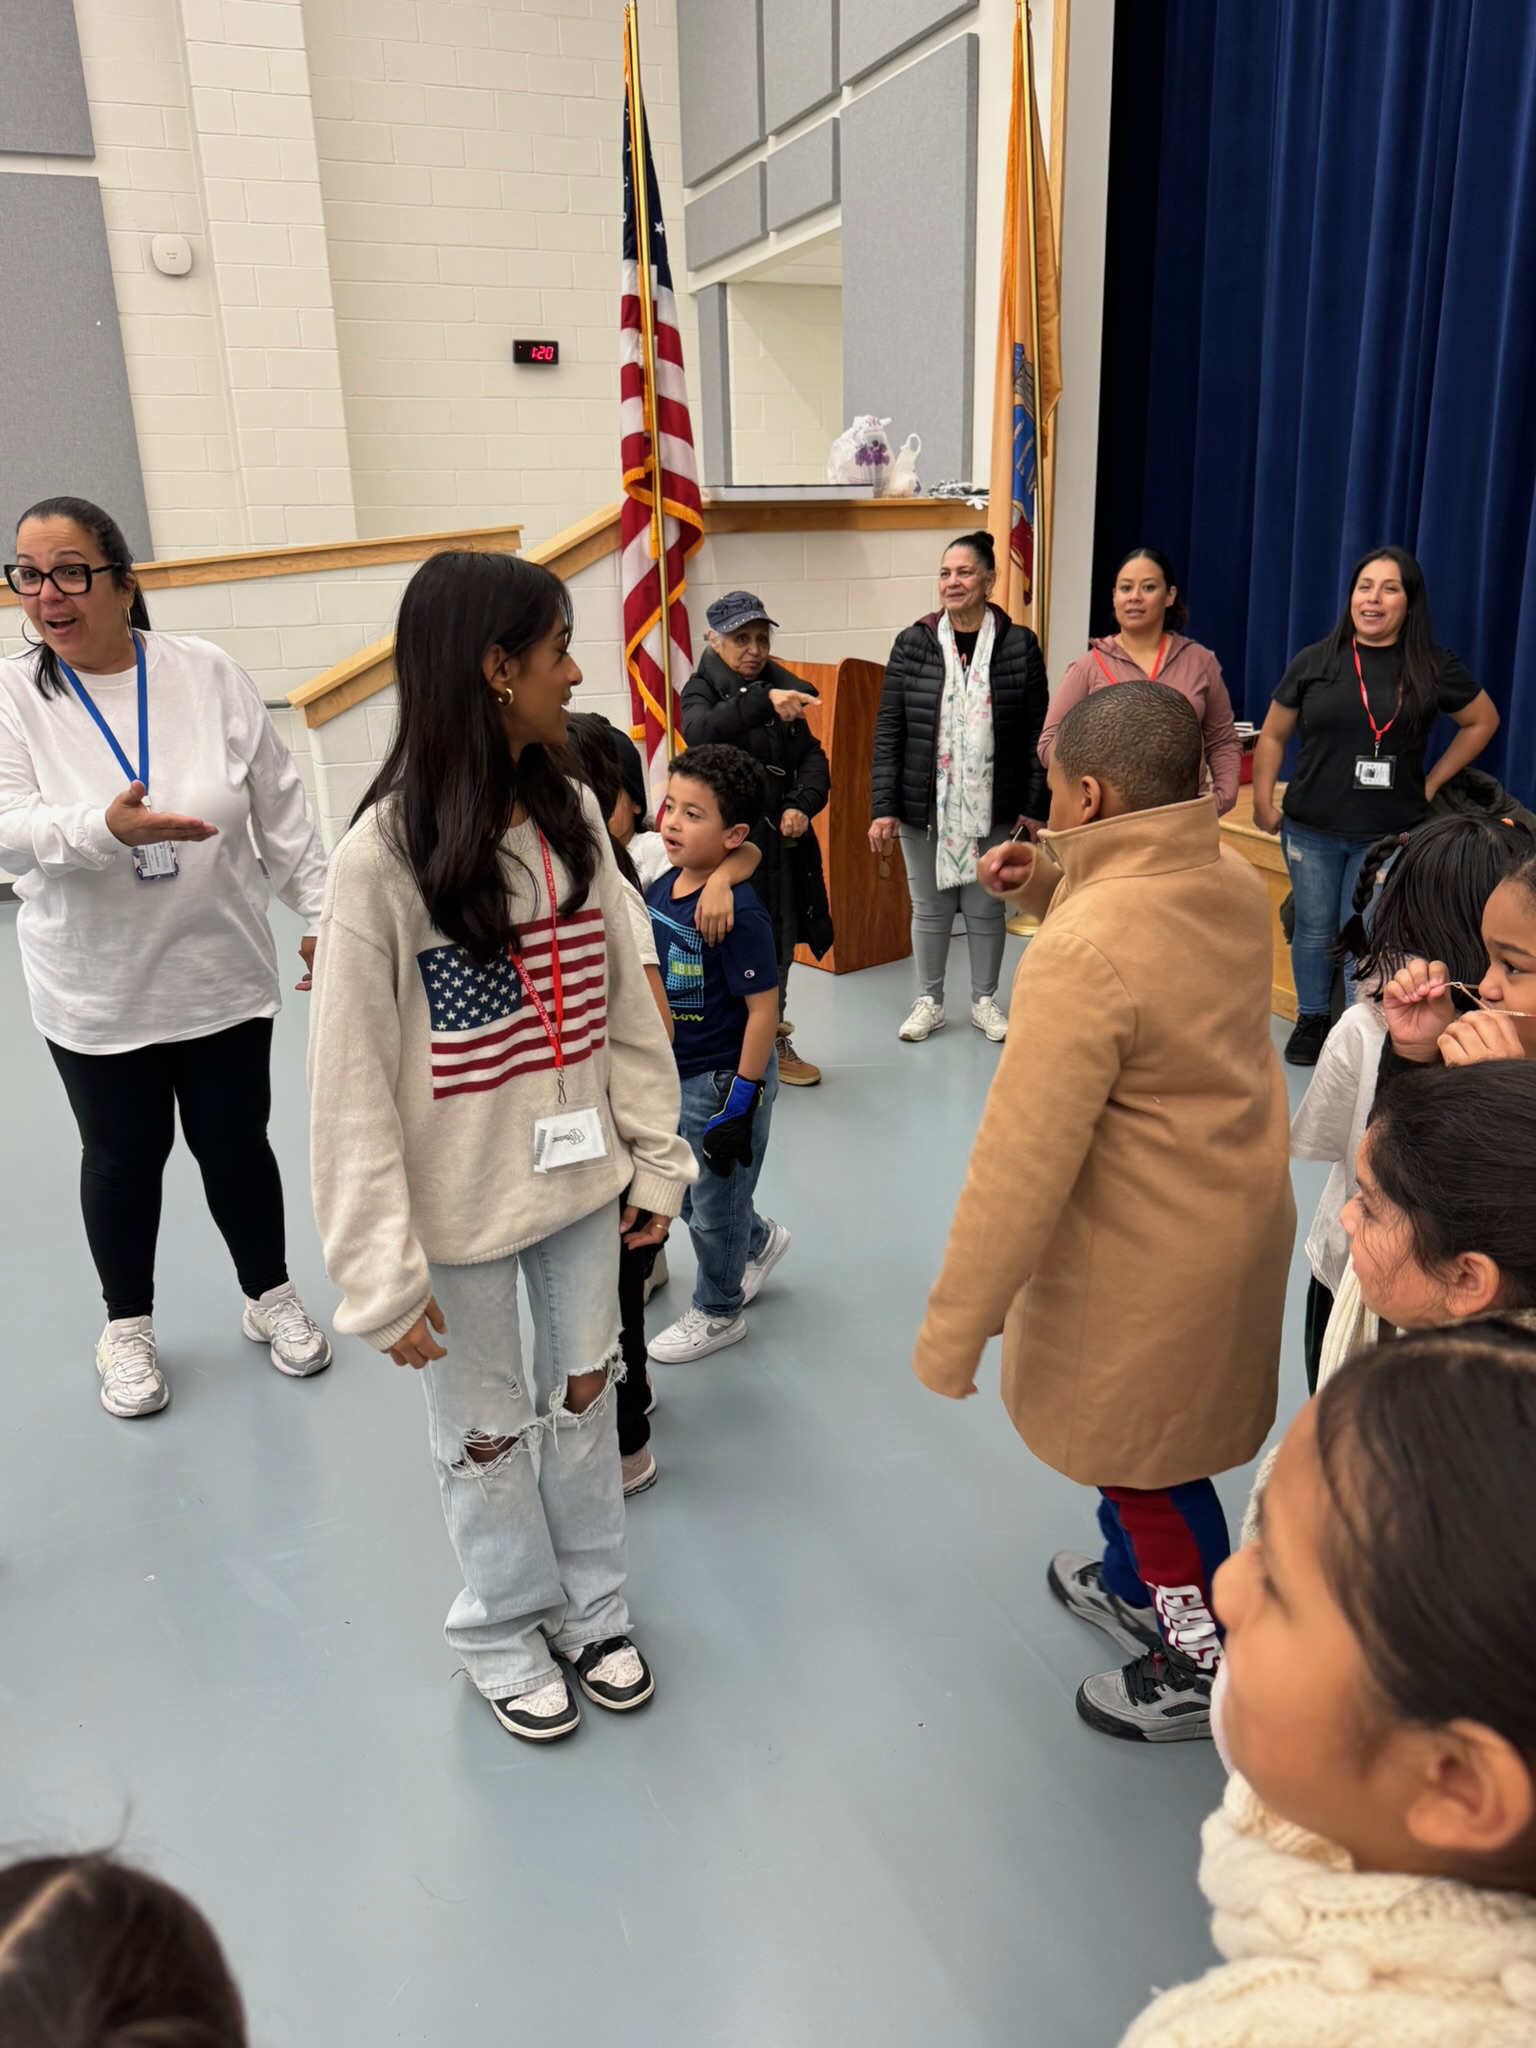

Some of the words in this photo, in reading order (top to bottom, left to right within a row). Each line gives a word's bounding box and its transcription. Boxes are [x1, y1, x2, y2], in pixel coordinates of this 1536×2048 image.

[531, 345, 554, 360] 1:20
[518, 963, 533, 991] SCHOOLS
[673, 962, 701, 976] 1919
[531, 991, 545, 1013] PUBLIC
[542, 1012, 555, 1036] PASSAIC
[672, 1010, 704, 1021] ion
